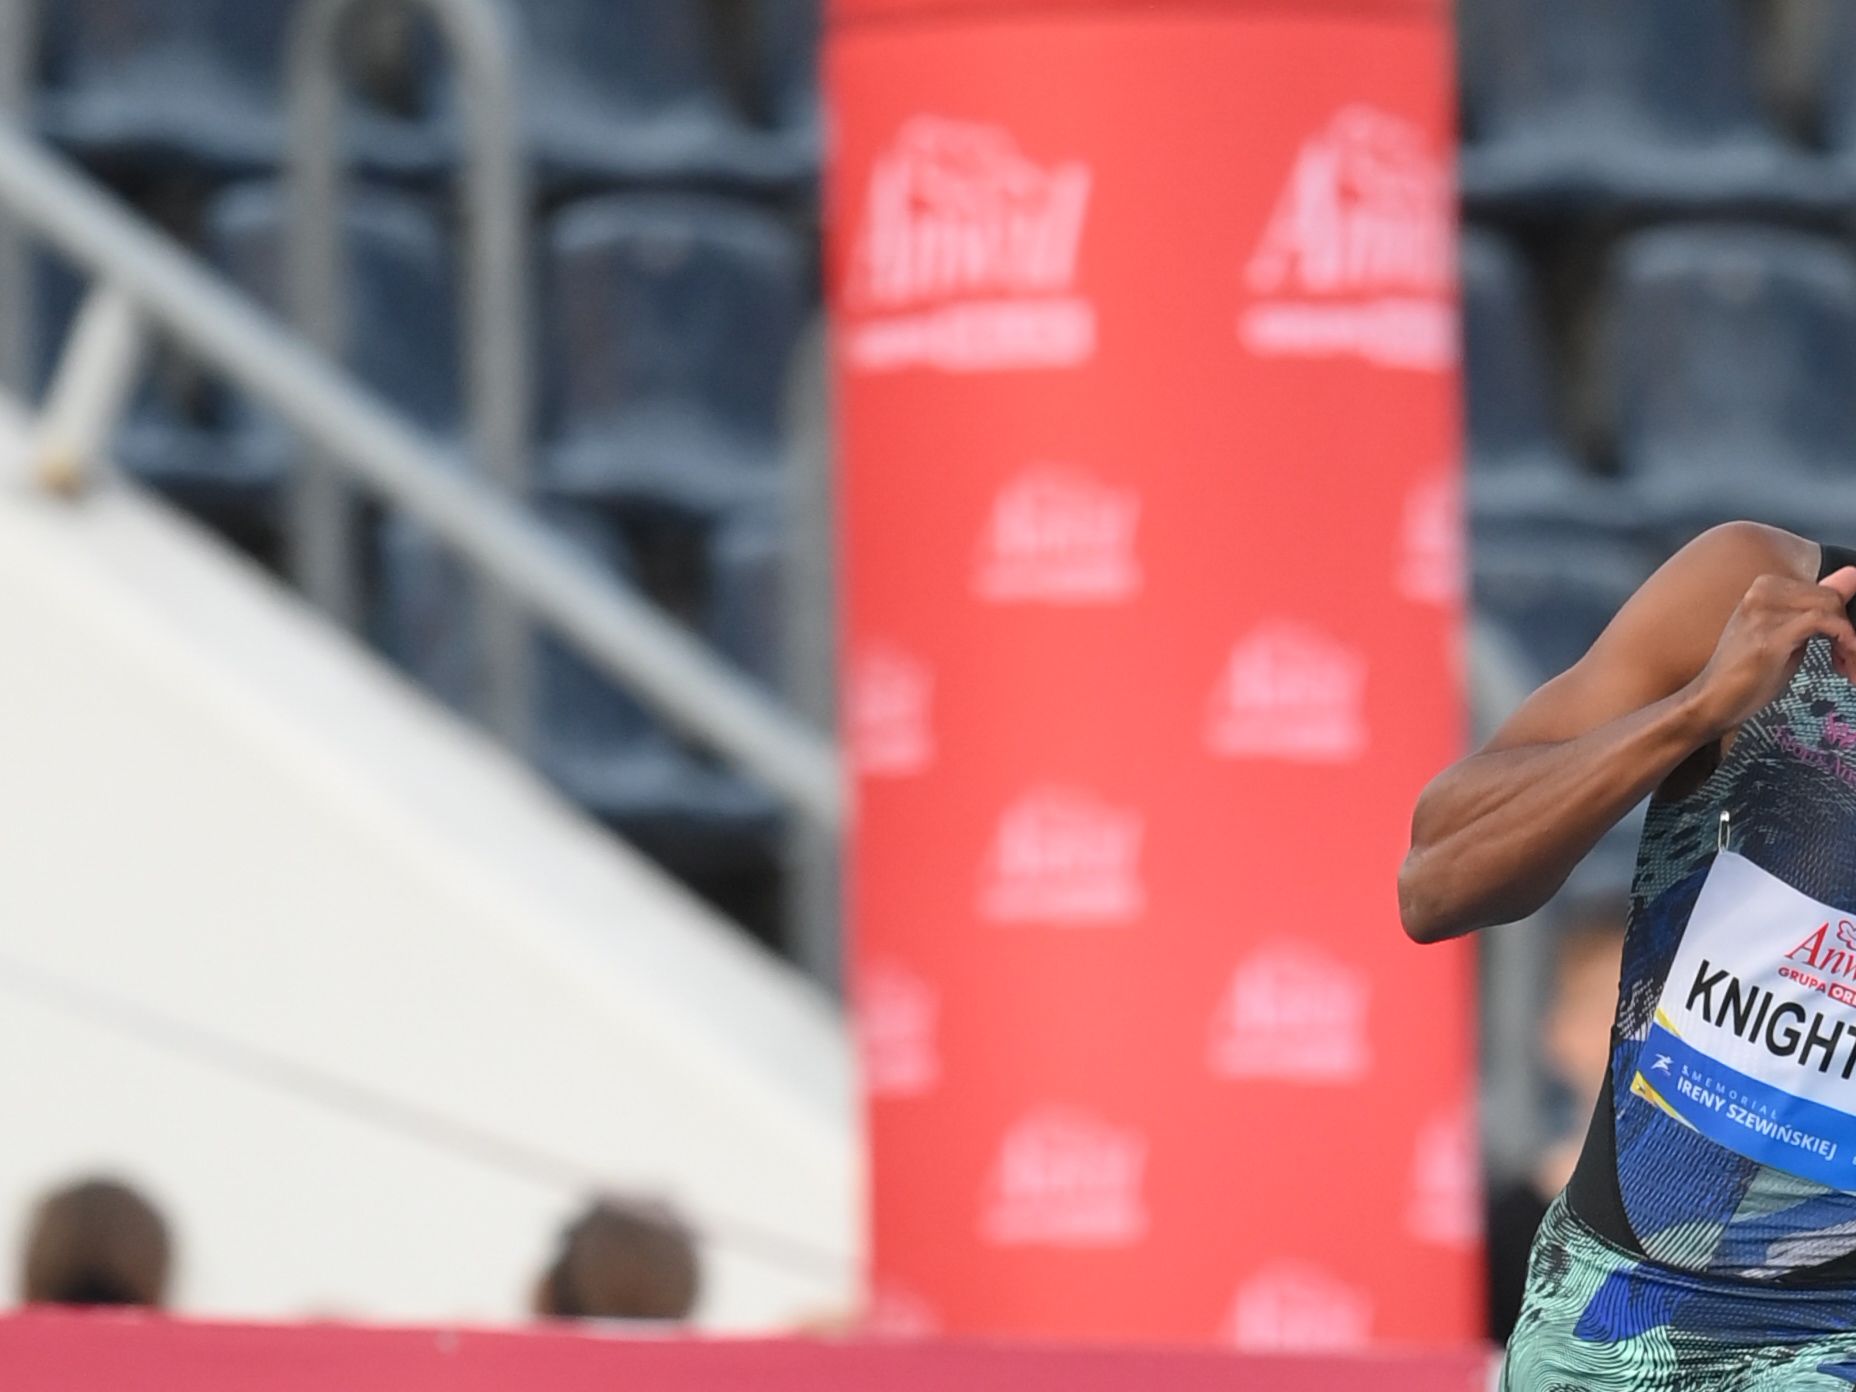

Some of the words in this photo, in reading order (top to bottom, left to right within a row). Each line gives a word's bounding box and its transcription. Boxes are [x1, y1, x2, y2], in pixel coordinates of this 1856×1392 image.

[1778, 967, 1826, 994] GRUPA
[1677, 1076, 1726, 1112] IRENY
[1726, 1104, 1837, 1161] SZEWIŃSKIEJ
